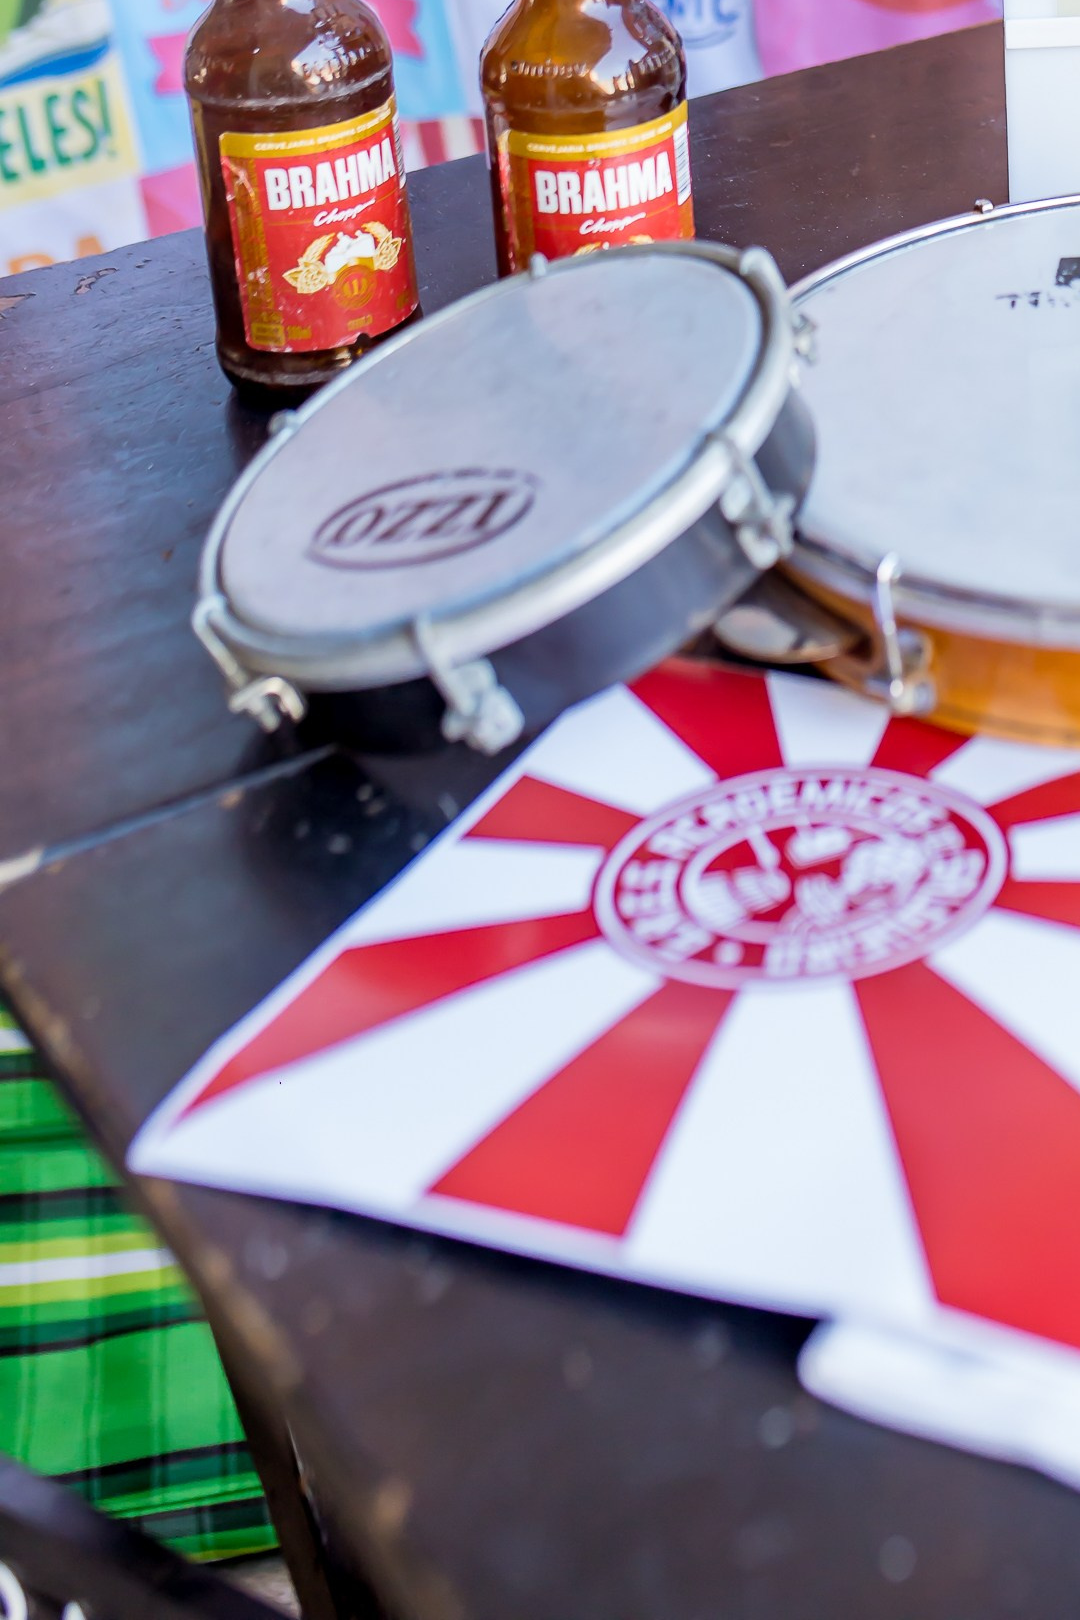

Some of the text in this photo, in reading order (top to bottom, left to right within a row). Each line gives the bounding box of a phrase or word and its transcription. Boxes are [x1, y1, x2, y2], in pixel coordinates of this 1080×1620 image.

[263, 136, 396, 212] BRAHMA
[533, 150, 674, 215] BRAHMA
[312, 197, 377, 228] Chopp
[578, 211, 648, 236] Chopp
